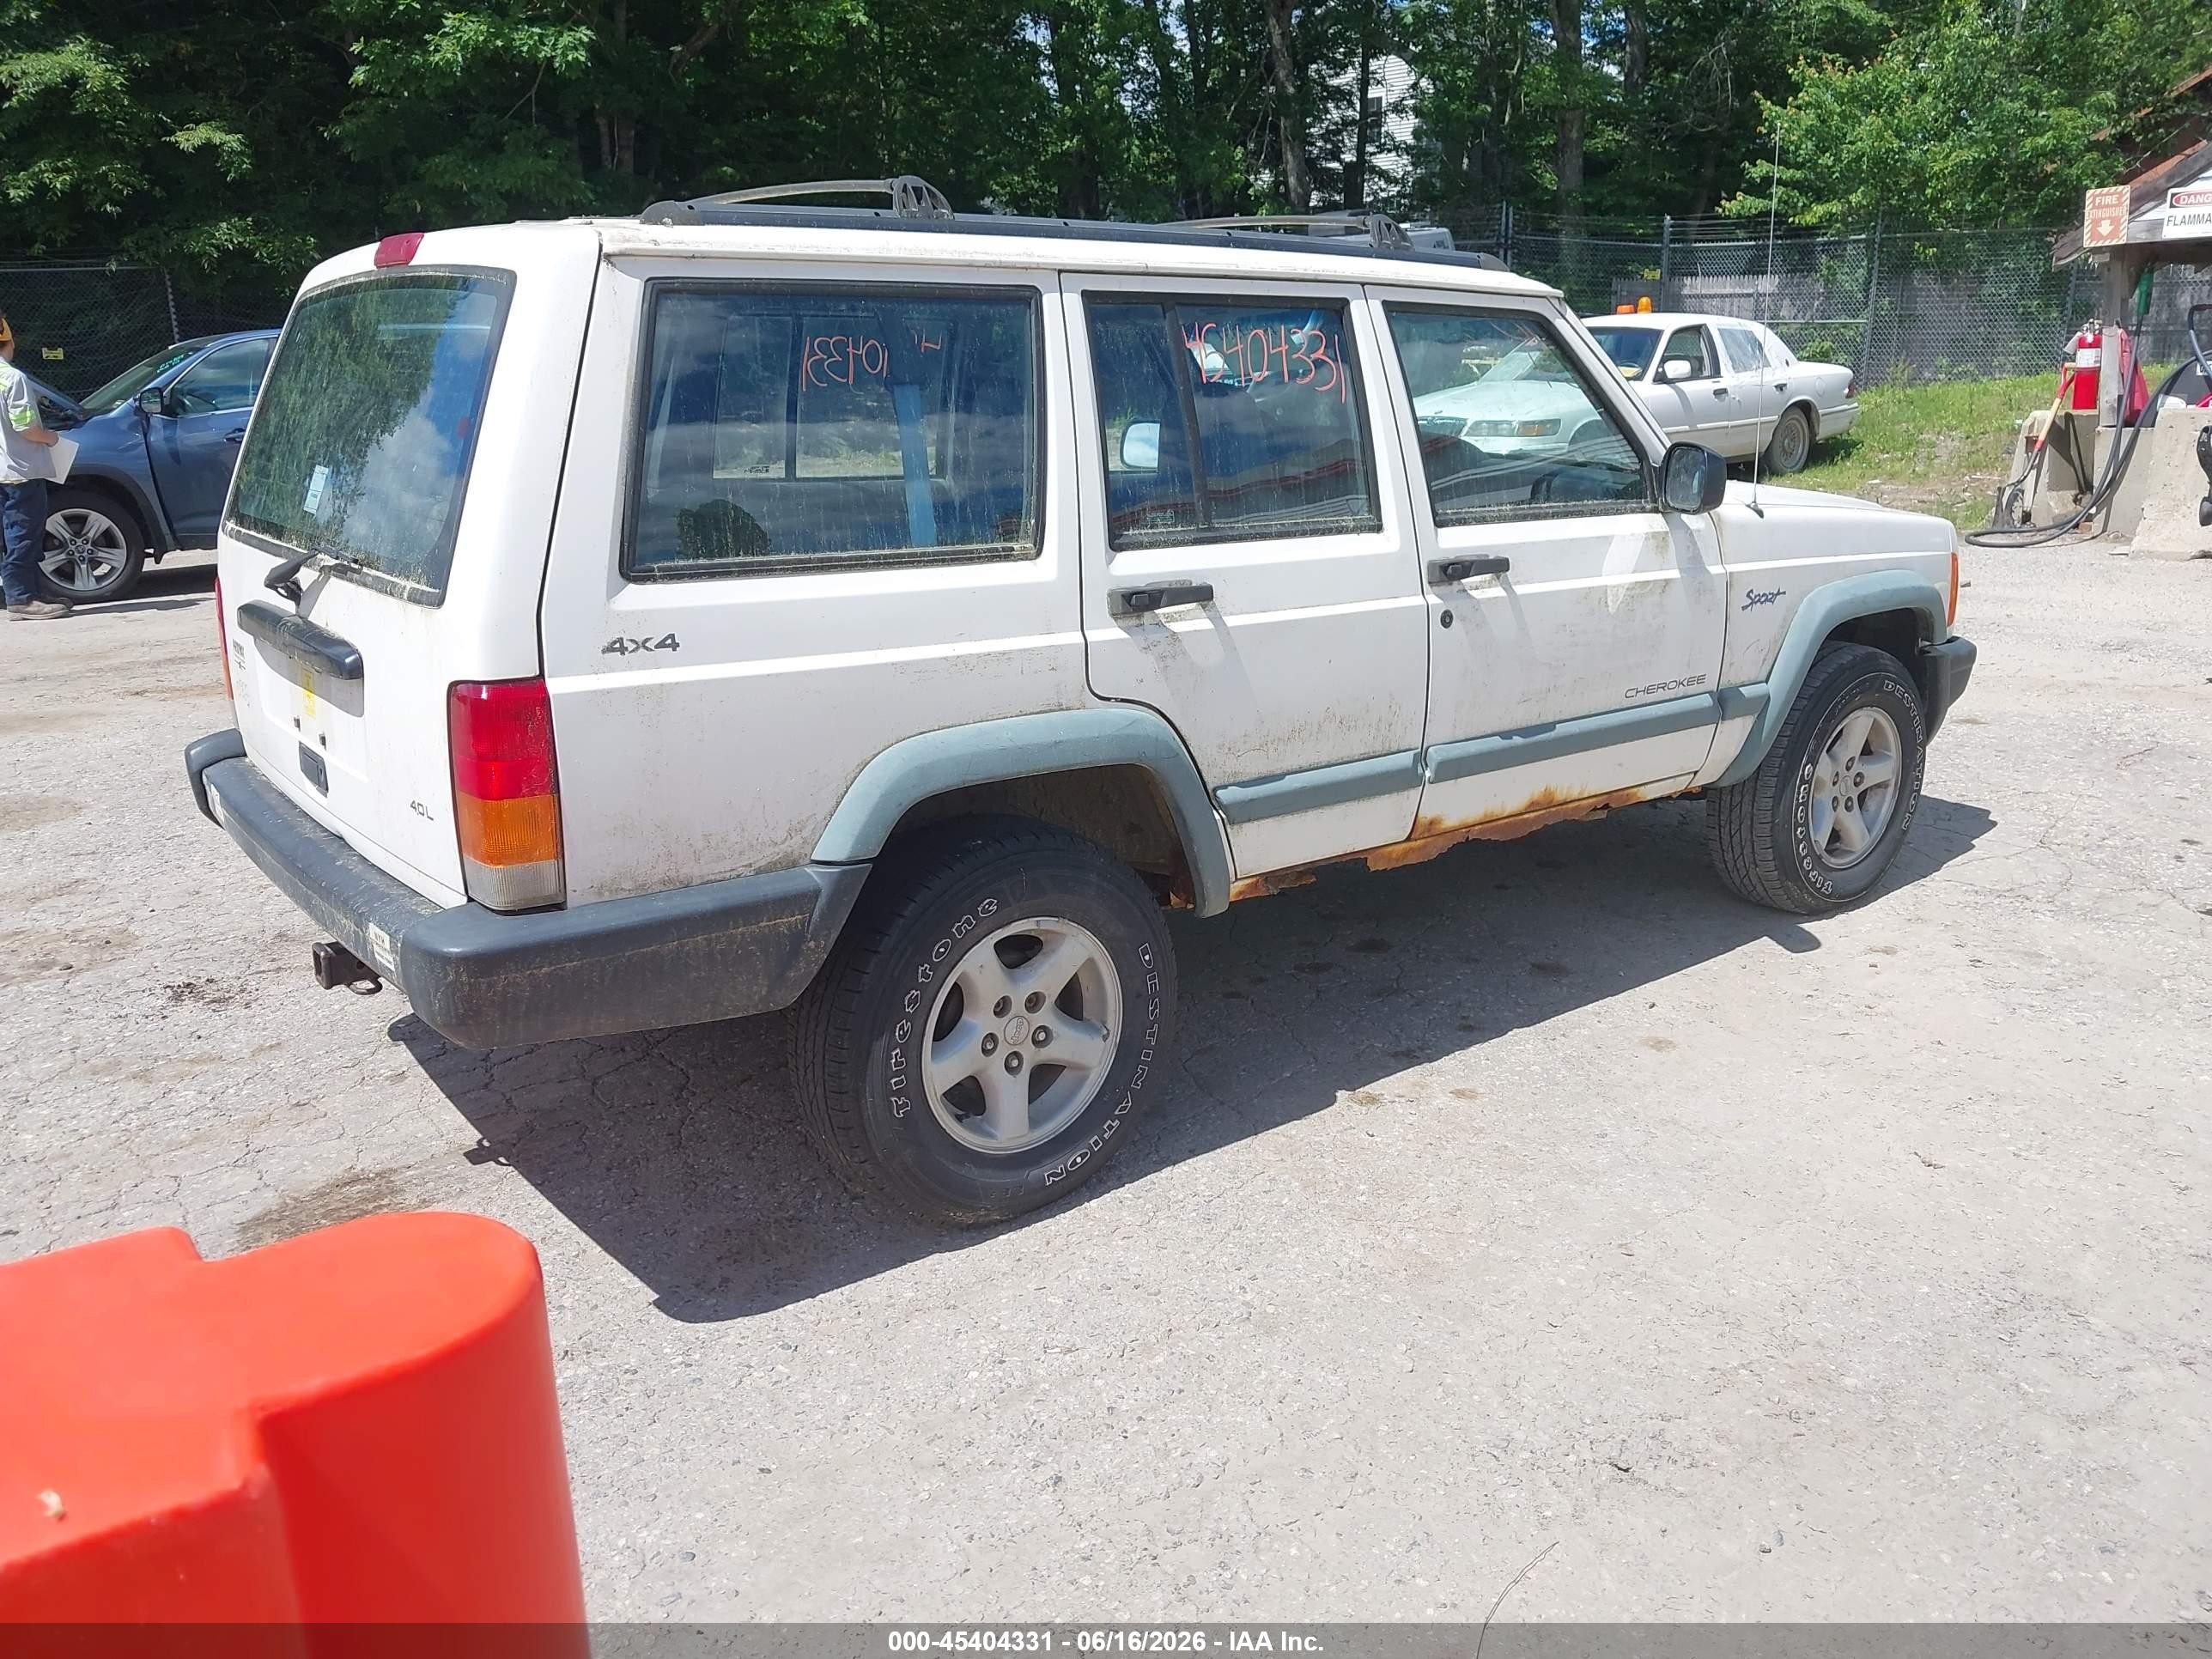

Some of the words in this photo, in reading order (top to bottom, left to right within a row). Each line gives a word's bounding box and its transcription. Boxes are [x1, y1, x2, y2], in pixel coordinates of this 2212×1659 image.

[2095, 194, 2120, 206] FIRE
[2179, 193, 2212, 204] DANG
[2086, 206, 2127, 220] EXTINGUISHER
[2166, 212, 2212, 227] FLAMMA
[1182, 321, 1346, 404] 45404331
[1741, 586, 1786, 611] Sport
[1625, 673, 1707, 699] CHEROKEE
[1882, 679, 1924, 831] DESTINATION
[1044, 941, 1160, 1187] DESTINATION
